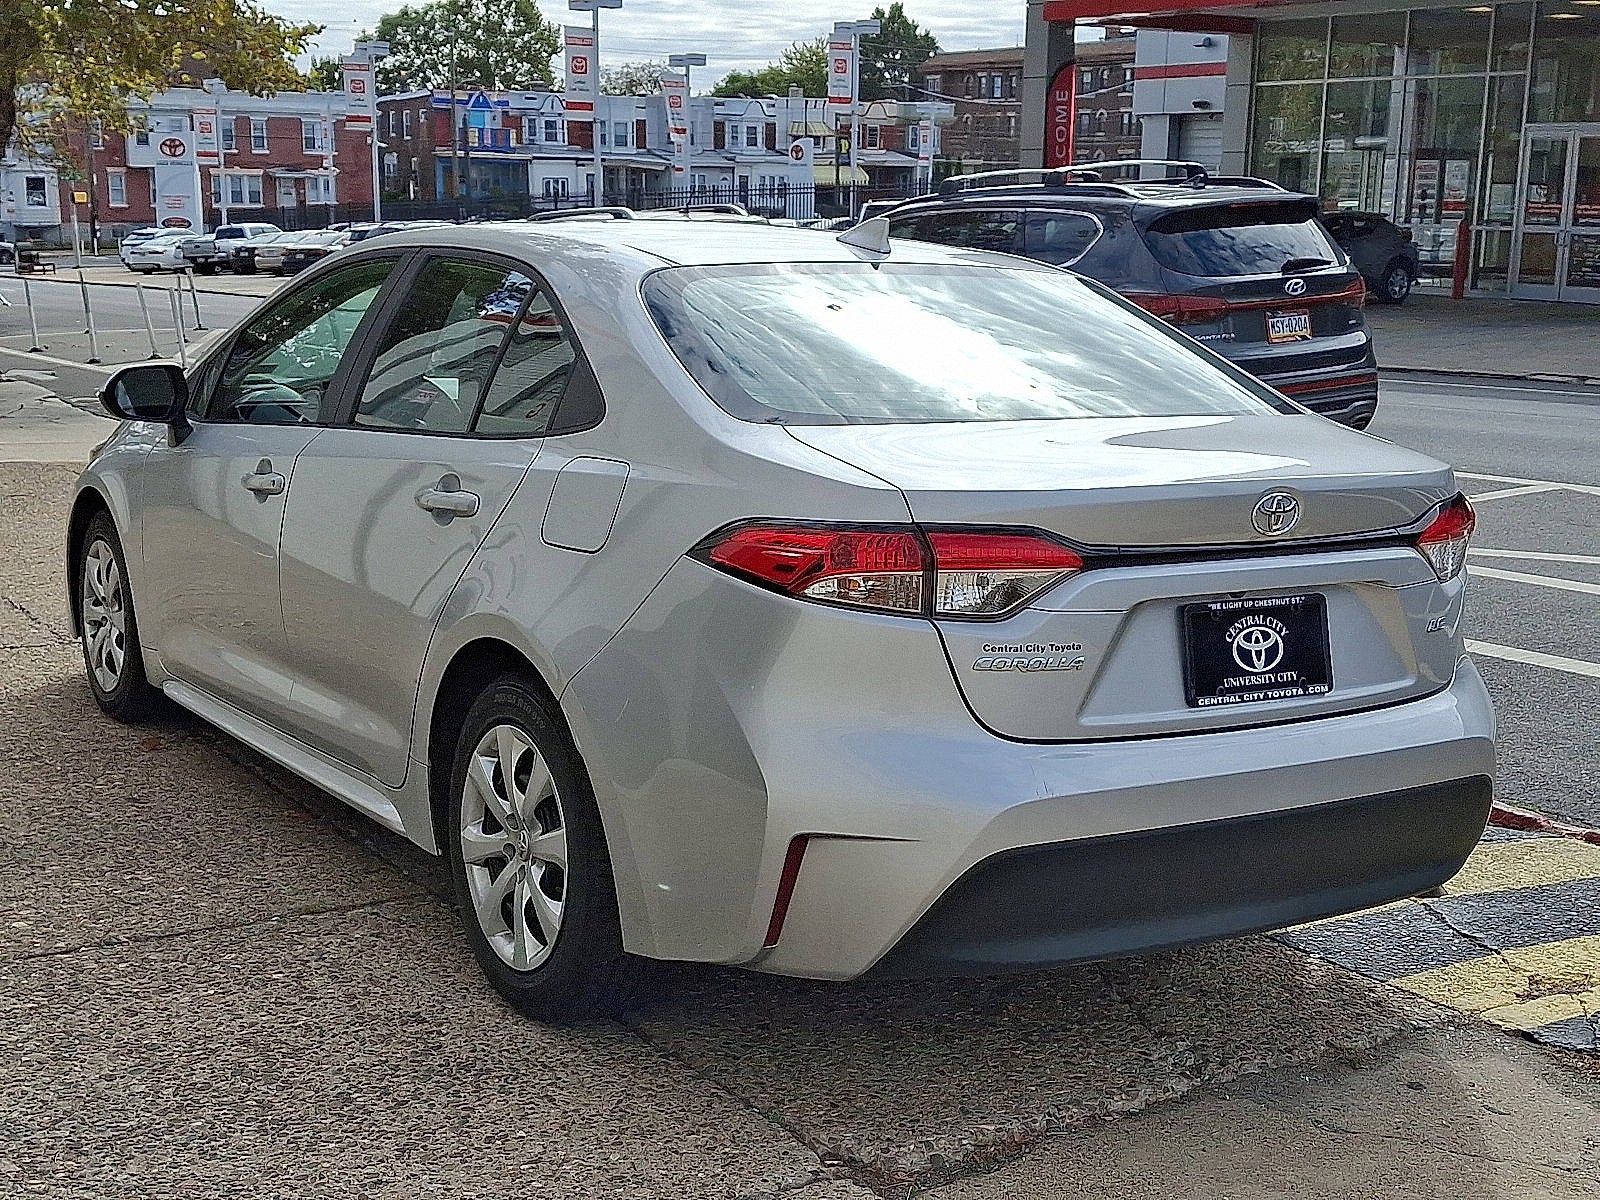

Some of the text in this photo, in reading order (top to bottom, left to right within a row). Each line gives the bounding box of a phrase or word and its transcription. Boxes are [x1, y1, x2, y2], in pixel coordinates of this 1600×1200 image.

[1222, 601, 1242, 610] LIGHT
[1243, 600, 1253, 608] UP
[1254, 597, 1290, 608] CHESTNUT
[1225, 614, 1290, 643] CENTRAL CITY
[982, 643, 1082, 654] Central City Toyota
[972, 655, 1085, 673] COROLLA
[1223, 671, 1298, 688] UNIVERSITY CITY
[1198, 685, 1329, 706] CENTRAL CITY TOYOTA .COM
